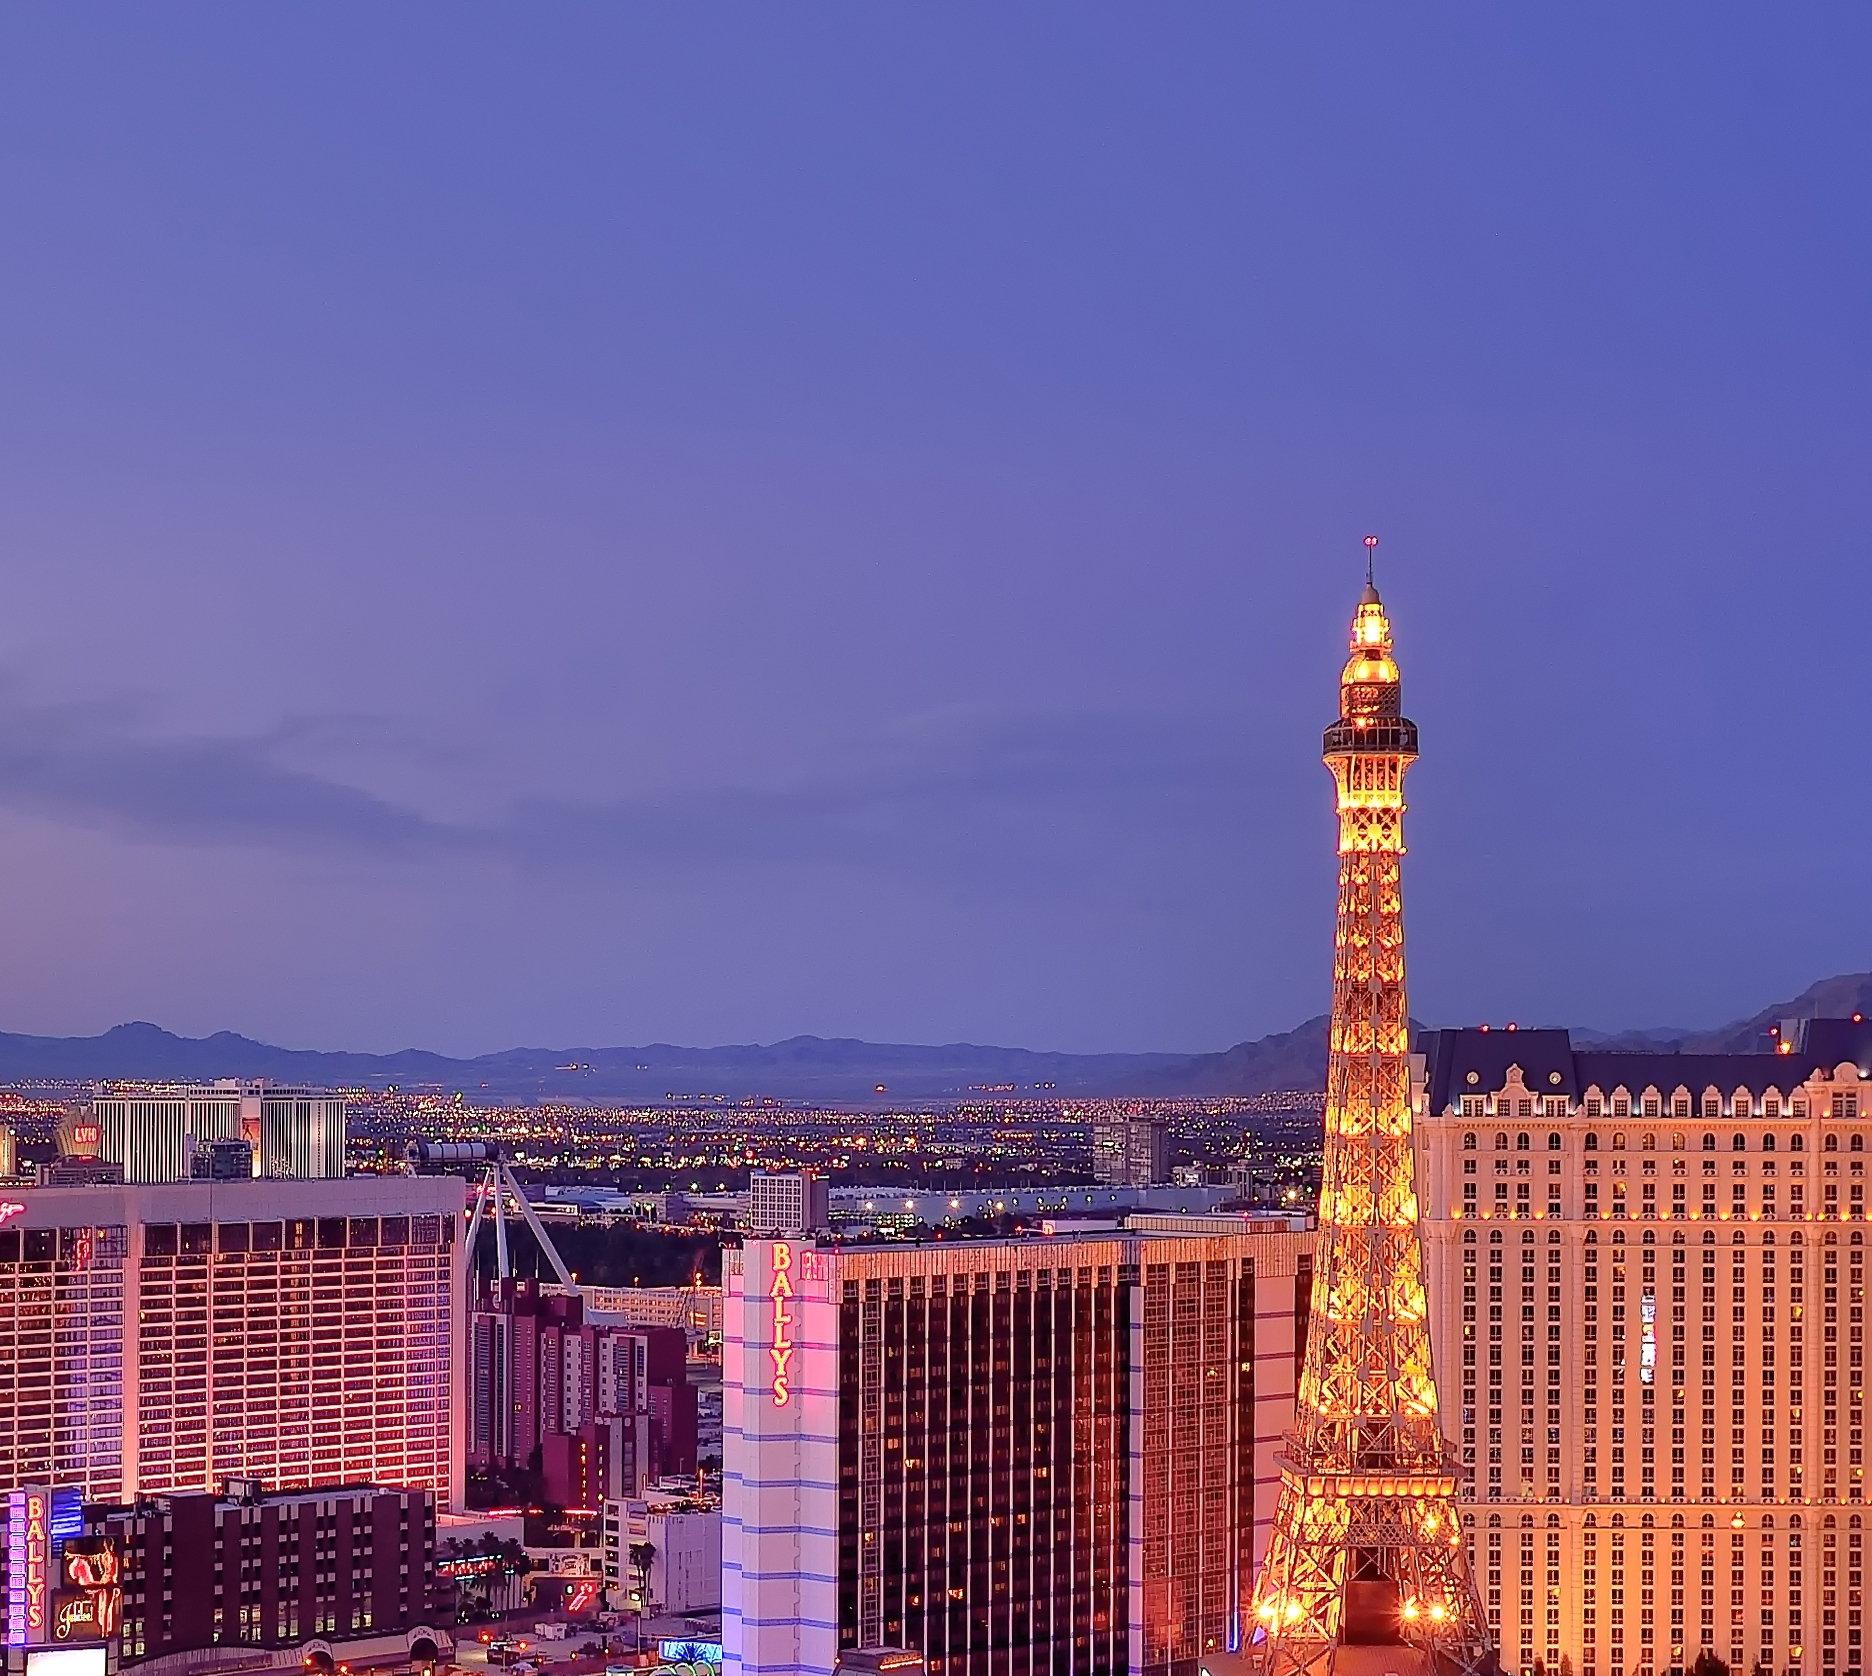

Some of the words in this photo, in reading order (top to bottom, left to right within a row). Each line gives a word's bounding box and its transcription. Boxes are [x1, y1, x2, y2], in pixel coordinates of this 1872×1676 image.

[75, 1126, 97, 1142] LVH
[769, 1243, 793, 1406] BALLYS
[27, 1497, 45, 1627] BALLYS
